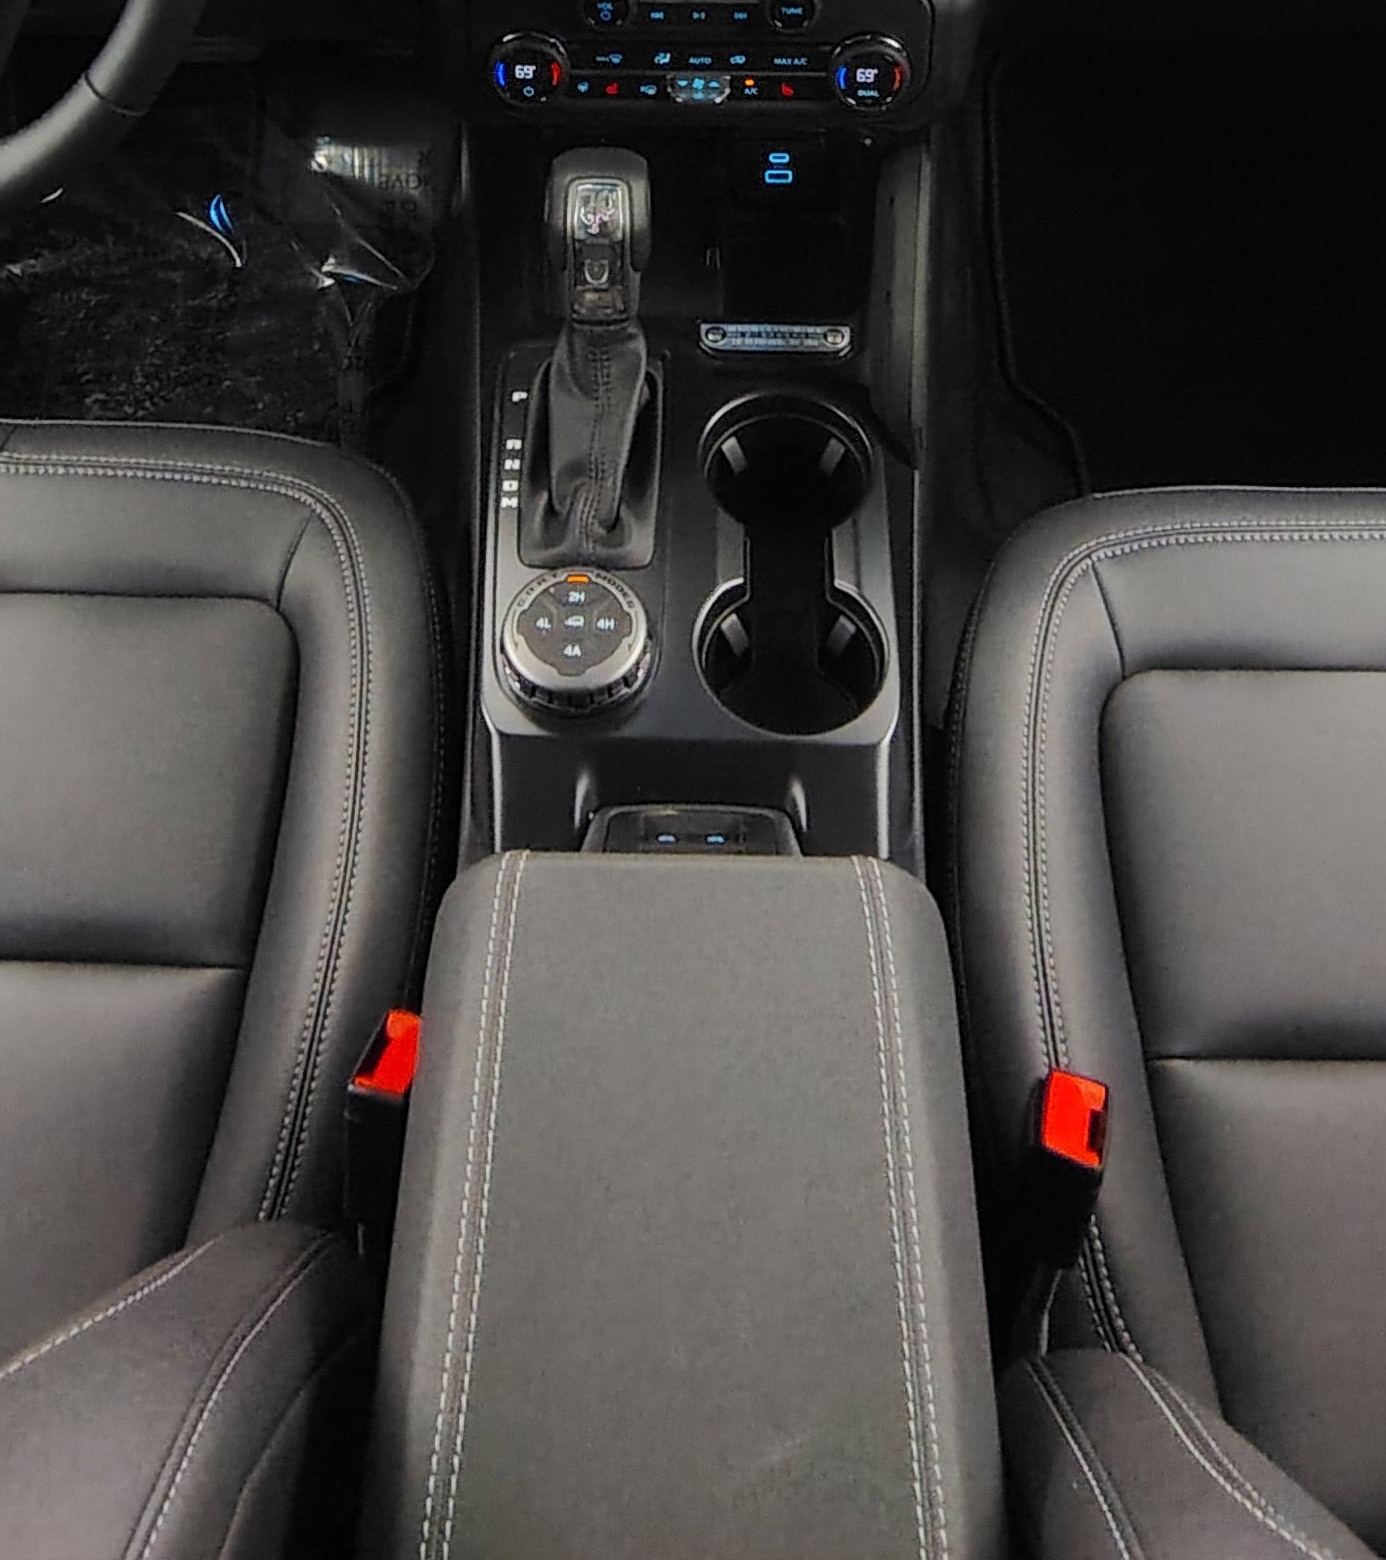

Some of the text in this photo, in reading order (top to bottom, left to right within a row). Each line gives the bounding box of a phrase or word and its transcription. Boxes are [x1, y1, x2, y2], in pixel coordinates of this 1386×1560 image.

[597, 2, 614, 11] VOL
[781, 6, 804, 16] TUNE
[688, 56, 712, 65] AUTO
[773, 57, 809, 66] MAX A/C
[744, 87, 759, 96] A/C
[857, 89, 880, 98] DUAL
[511, 391, 528, 402] P
[503, 459, 521, 470] N
[500, 497, 519, 508] M
[568, 591, 586, 603] 2H
[535, 618, 552, 630] 4L
[596, 618, 615, 631] 4H
[563, 643, 582, 657] 4A
